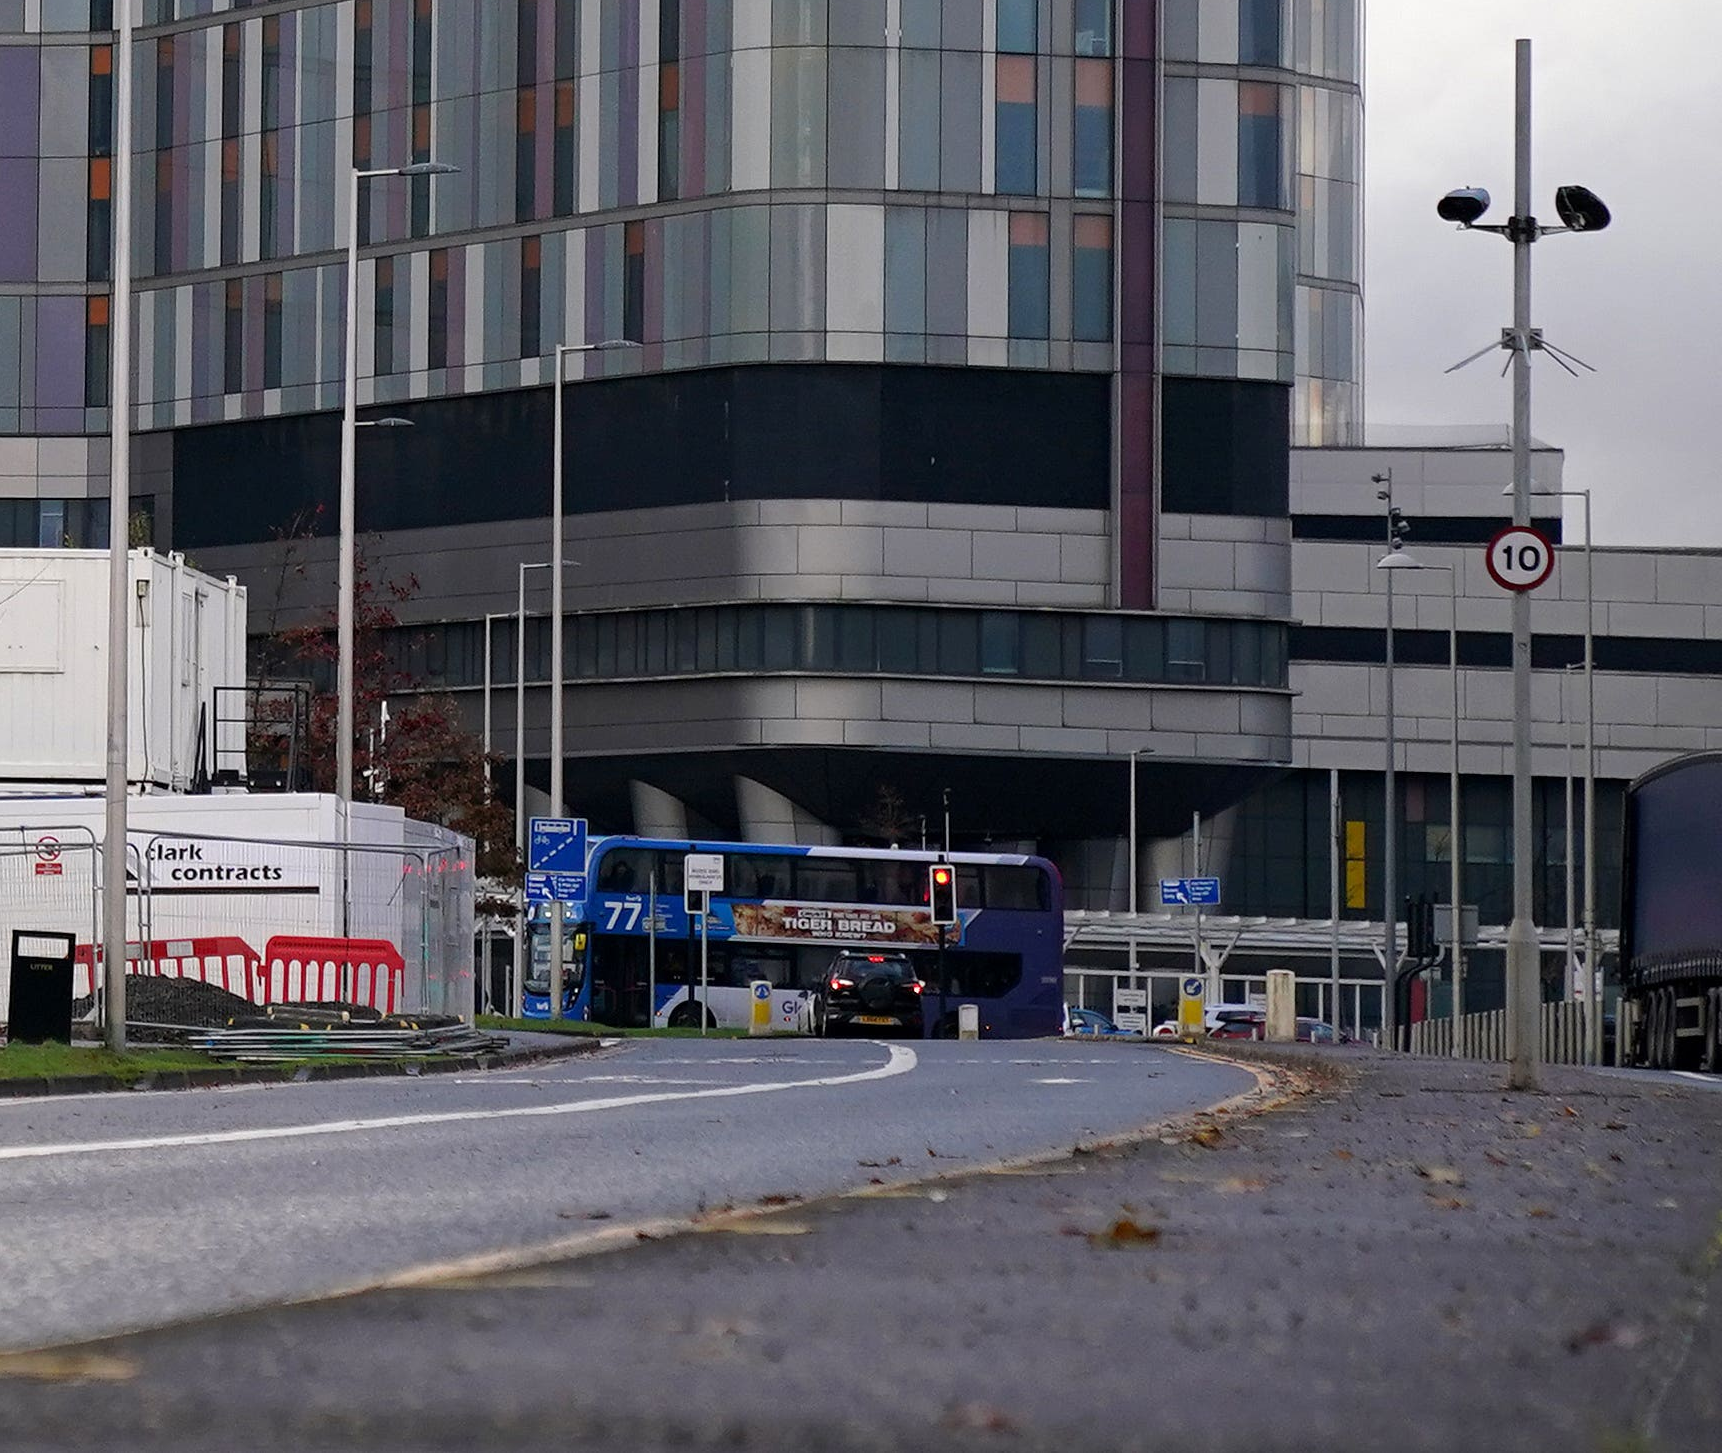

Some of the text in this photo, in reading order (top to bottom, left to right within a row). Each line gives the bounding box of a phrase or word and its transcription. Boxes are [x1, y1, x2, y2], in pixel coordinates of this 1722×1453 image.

[1502, 545, 1541, 572] 10
[145, 844, 203, 861] clark
[171, 865, 283, 881] contracts
[604, 901, 643, 931] 77
[782, 916, 833, 931] TIGER
[838, 920, 897, 934] BREAD
[30, 963, 54, 972] LITTER
